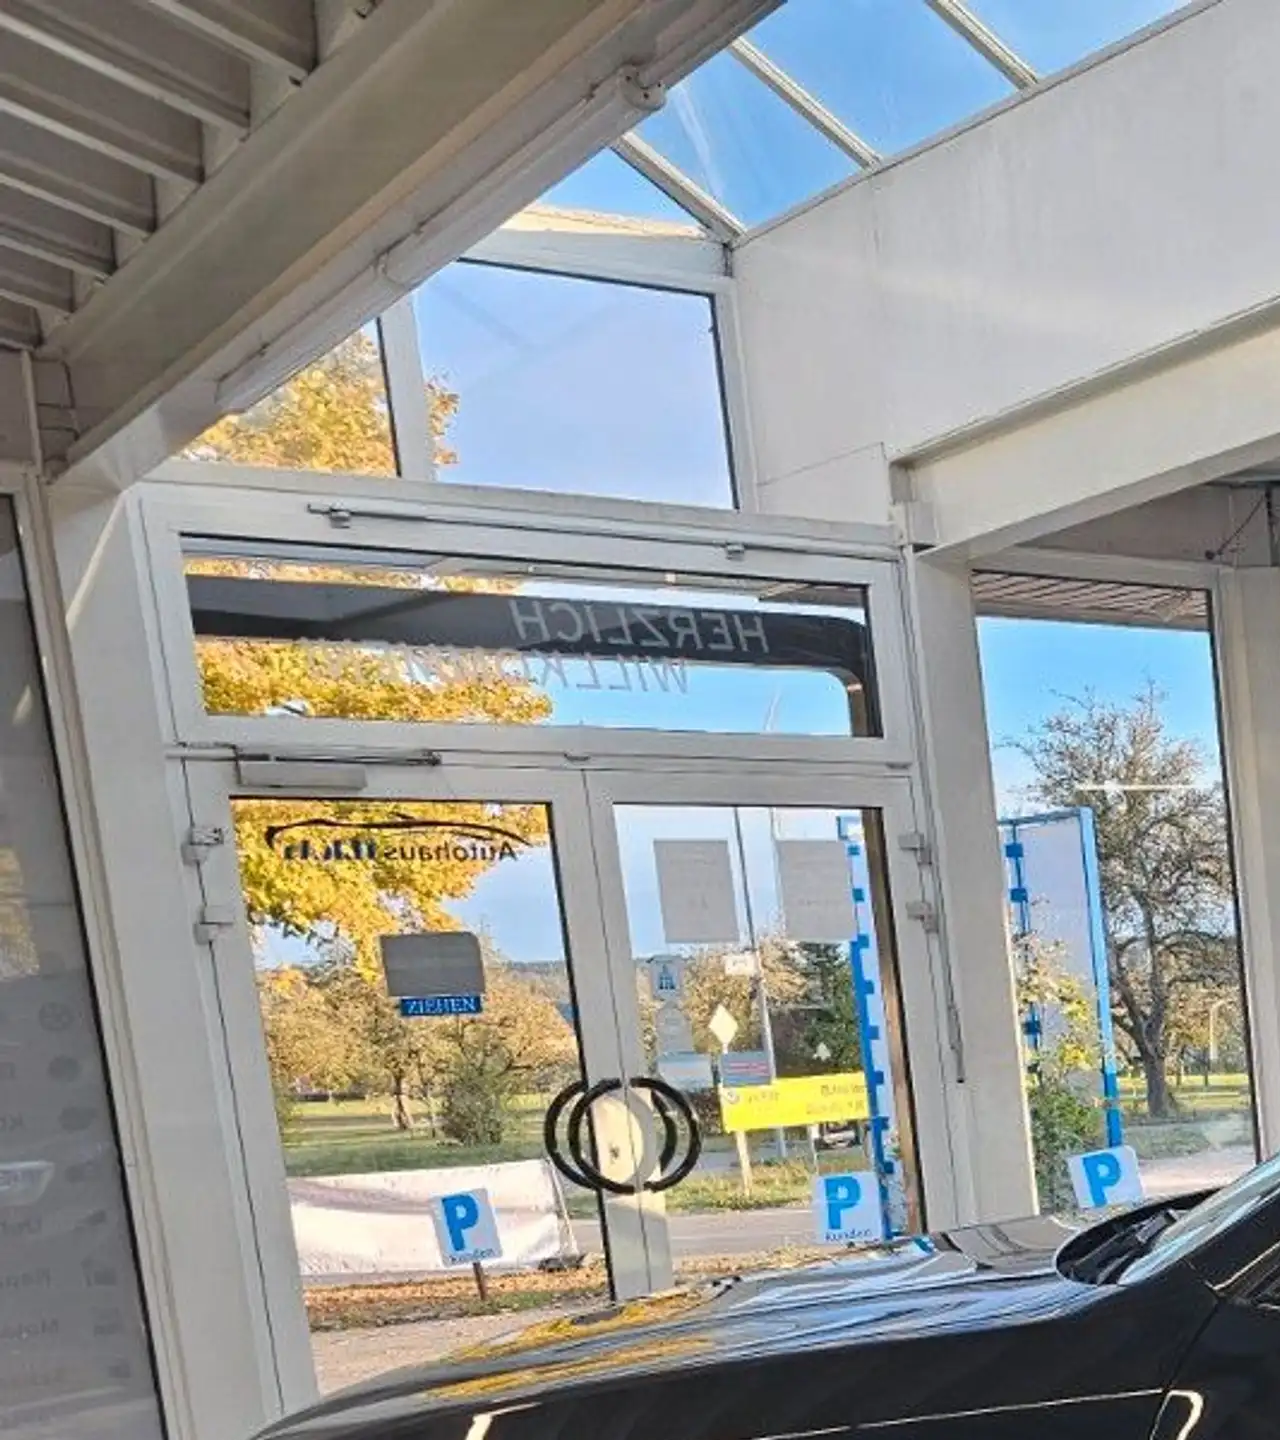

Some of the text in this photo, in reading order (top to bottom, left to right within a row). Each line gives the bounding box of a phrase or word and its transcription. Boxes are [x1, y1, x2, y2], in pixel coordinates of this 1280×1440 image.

[405, 998, 477, 1014] ZIEHEN
[824, 1175, 861, 1230] P
[1082, 1152, 1121, 1209] P
[441, 1194, 479, 1251] P
